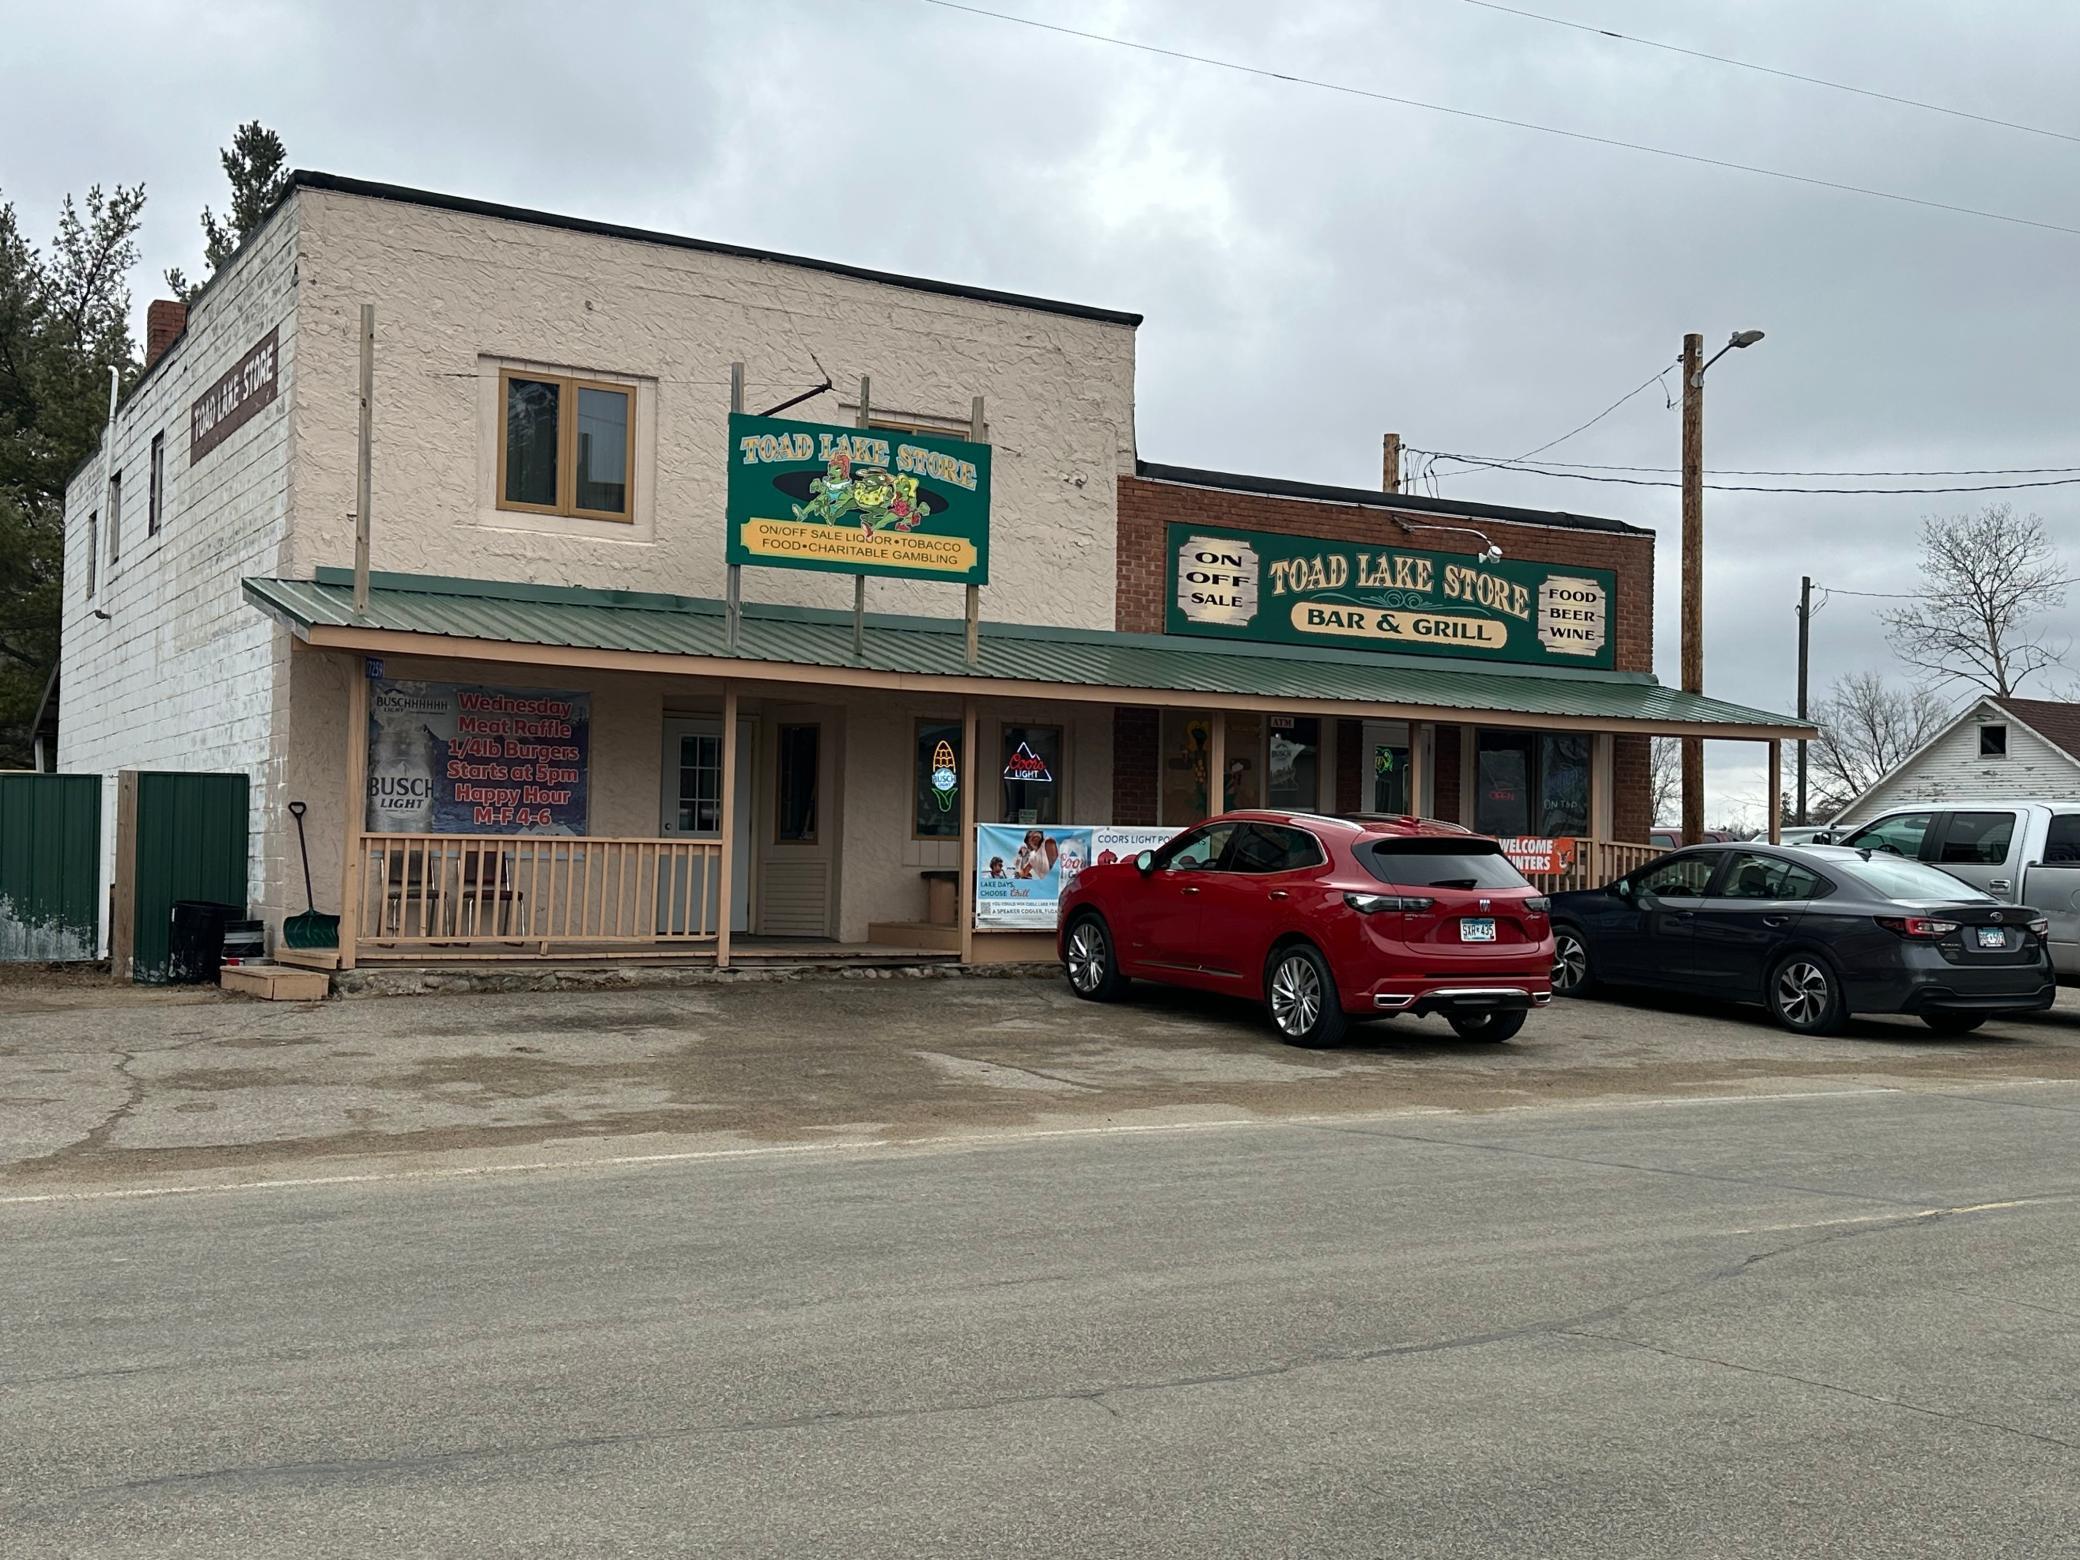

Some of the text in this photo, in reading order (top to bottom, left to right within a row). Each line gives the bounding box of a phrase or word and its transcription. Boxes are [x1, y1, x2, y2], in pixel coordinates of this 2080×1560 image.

[195, 342, 274, 442] TOAD LAKE STORE
[740, 432, 978, 491] TOAD LAKE STORE
[759, 524, 962, 553] ON/OFF SALE LIQUOR TOBACCO
[762, 538, 958, 565] FOOD CHARITABLE GAMBLING
[1195, 552, 1242, 567] ON
[1186, 571, 1250, 587] OFF
[1268, 551, 1531, 622] TOAD LAKE STORE
[1191, 592, 1243, 608] SALE
[1549, 588, 1597, 603] FOOD
[1550, 608, 1595, 622] BEER
[1307, 608, 1492, 641] BAR & GRILL
[1550, 626, 1596, 641] WINE
[457, 692, 572, 718] Wednesday
[458, 715, 572, 737] Meat Raffle
[1272, 718, 1292, 727] ATM
[448, 738, 579, 762] 1/4lb Burgers
[1009, 753, 1046, 770] Coors
[447, 760, 579, 785] Starts at 5pm
[1015, 769, 1039, 778] LIGHT
[369, 776, 433, 799] BUSCH
[455, 783, 571, 806] Happy Hour
[1488, 791, 1515, 801] OPEN
[380, 798, 425, 809] LIGHT
[473, 807, 551, 825] M-F 4-6
[1097, 835, 1129, 844] COORS
[1131, 835, 1157, 844] LIGHT
[1498, 838, 1553, 855] WELCOME
[1506, 855, 1551, 871] UNTERS
